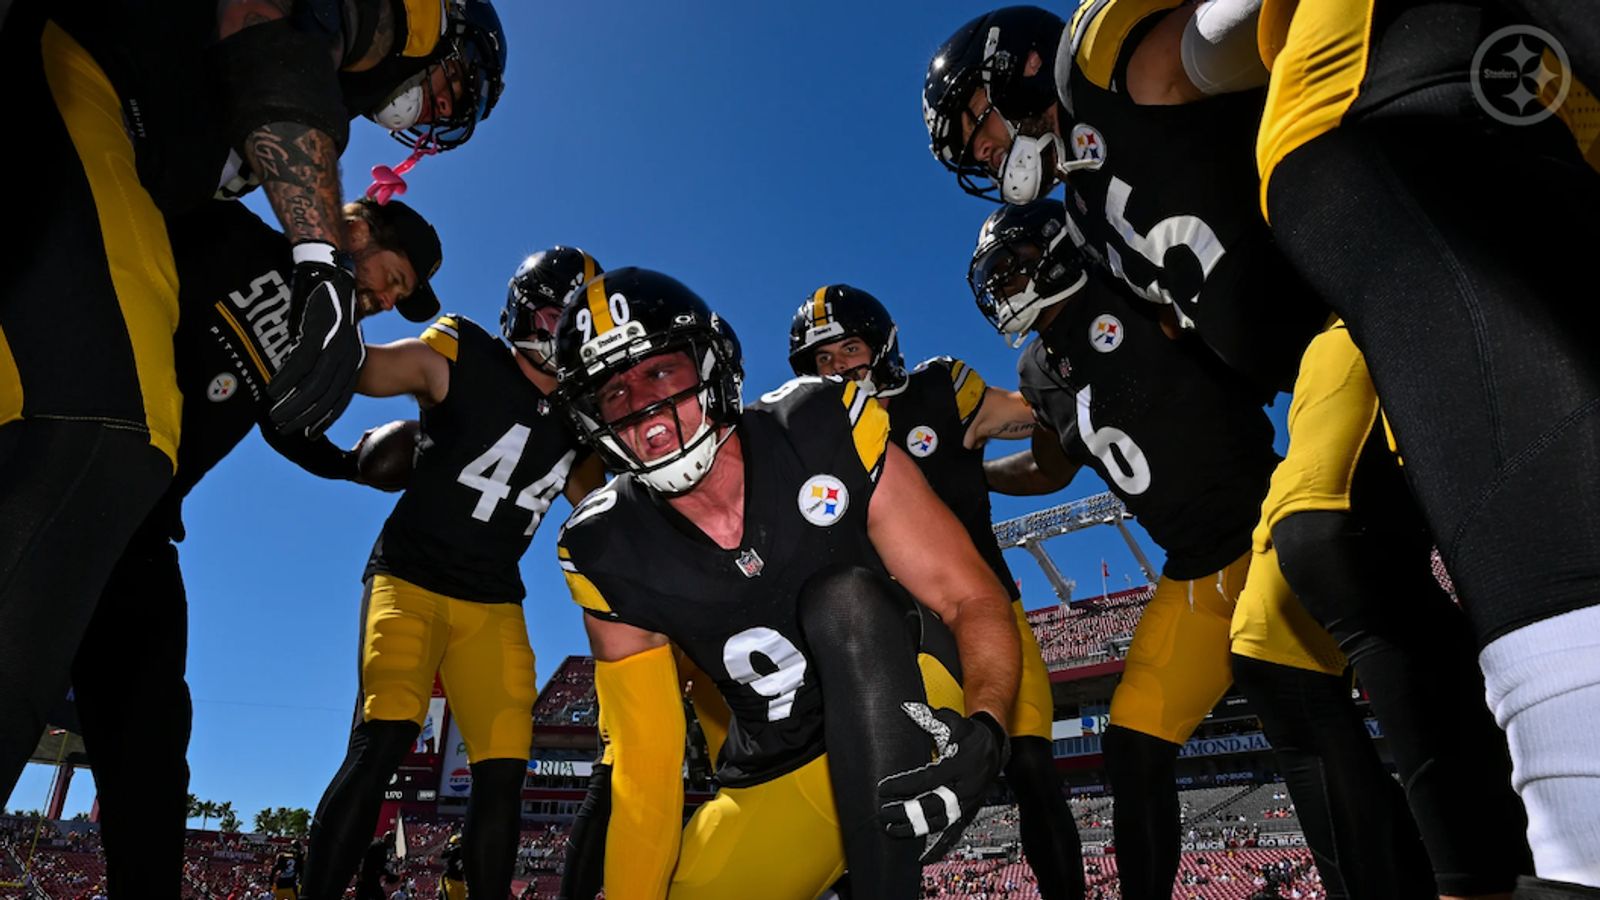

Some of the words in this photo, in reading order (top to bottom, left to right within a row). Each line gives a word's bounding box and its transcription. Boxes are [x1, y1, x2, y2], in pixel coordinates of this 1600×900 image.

[457, 422, 576, 537] 44
[1076, 384, 1151, 495] 6
[723, 626, 807, 722] 9
